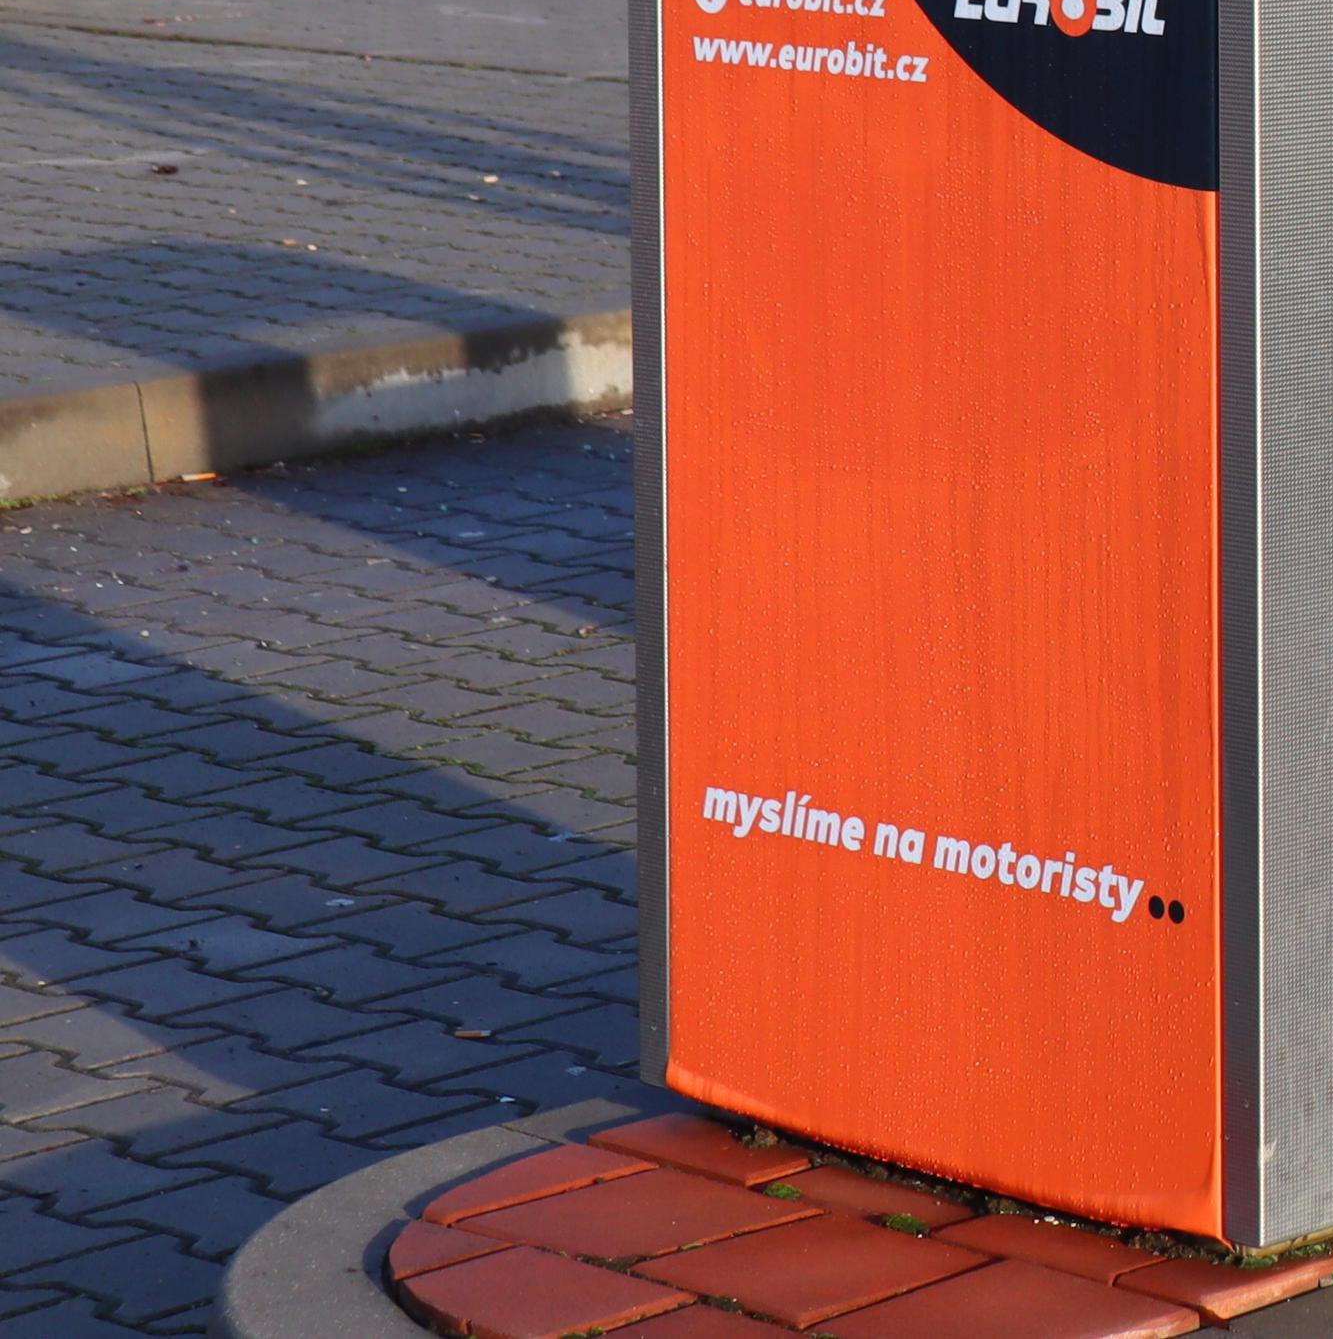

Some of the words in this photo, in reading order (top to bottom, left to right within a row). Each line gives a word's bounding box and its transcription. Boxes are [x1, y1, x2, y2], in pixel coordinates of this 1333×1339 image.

[692, 35, 930, 83] www.eurobit.cz
[702, 785, 866, 852] myslíme
[873, 822, 926, 865] na
